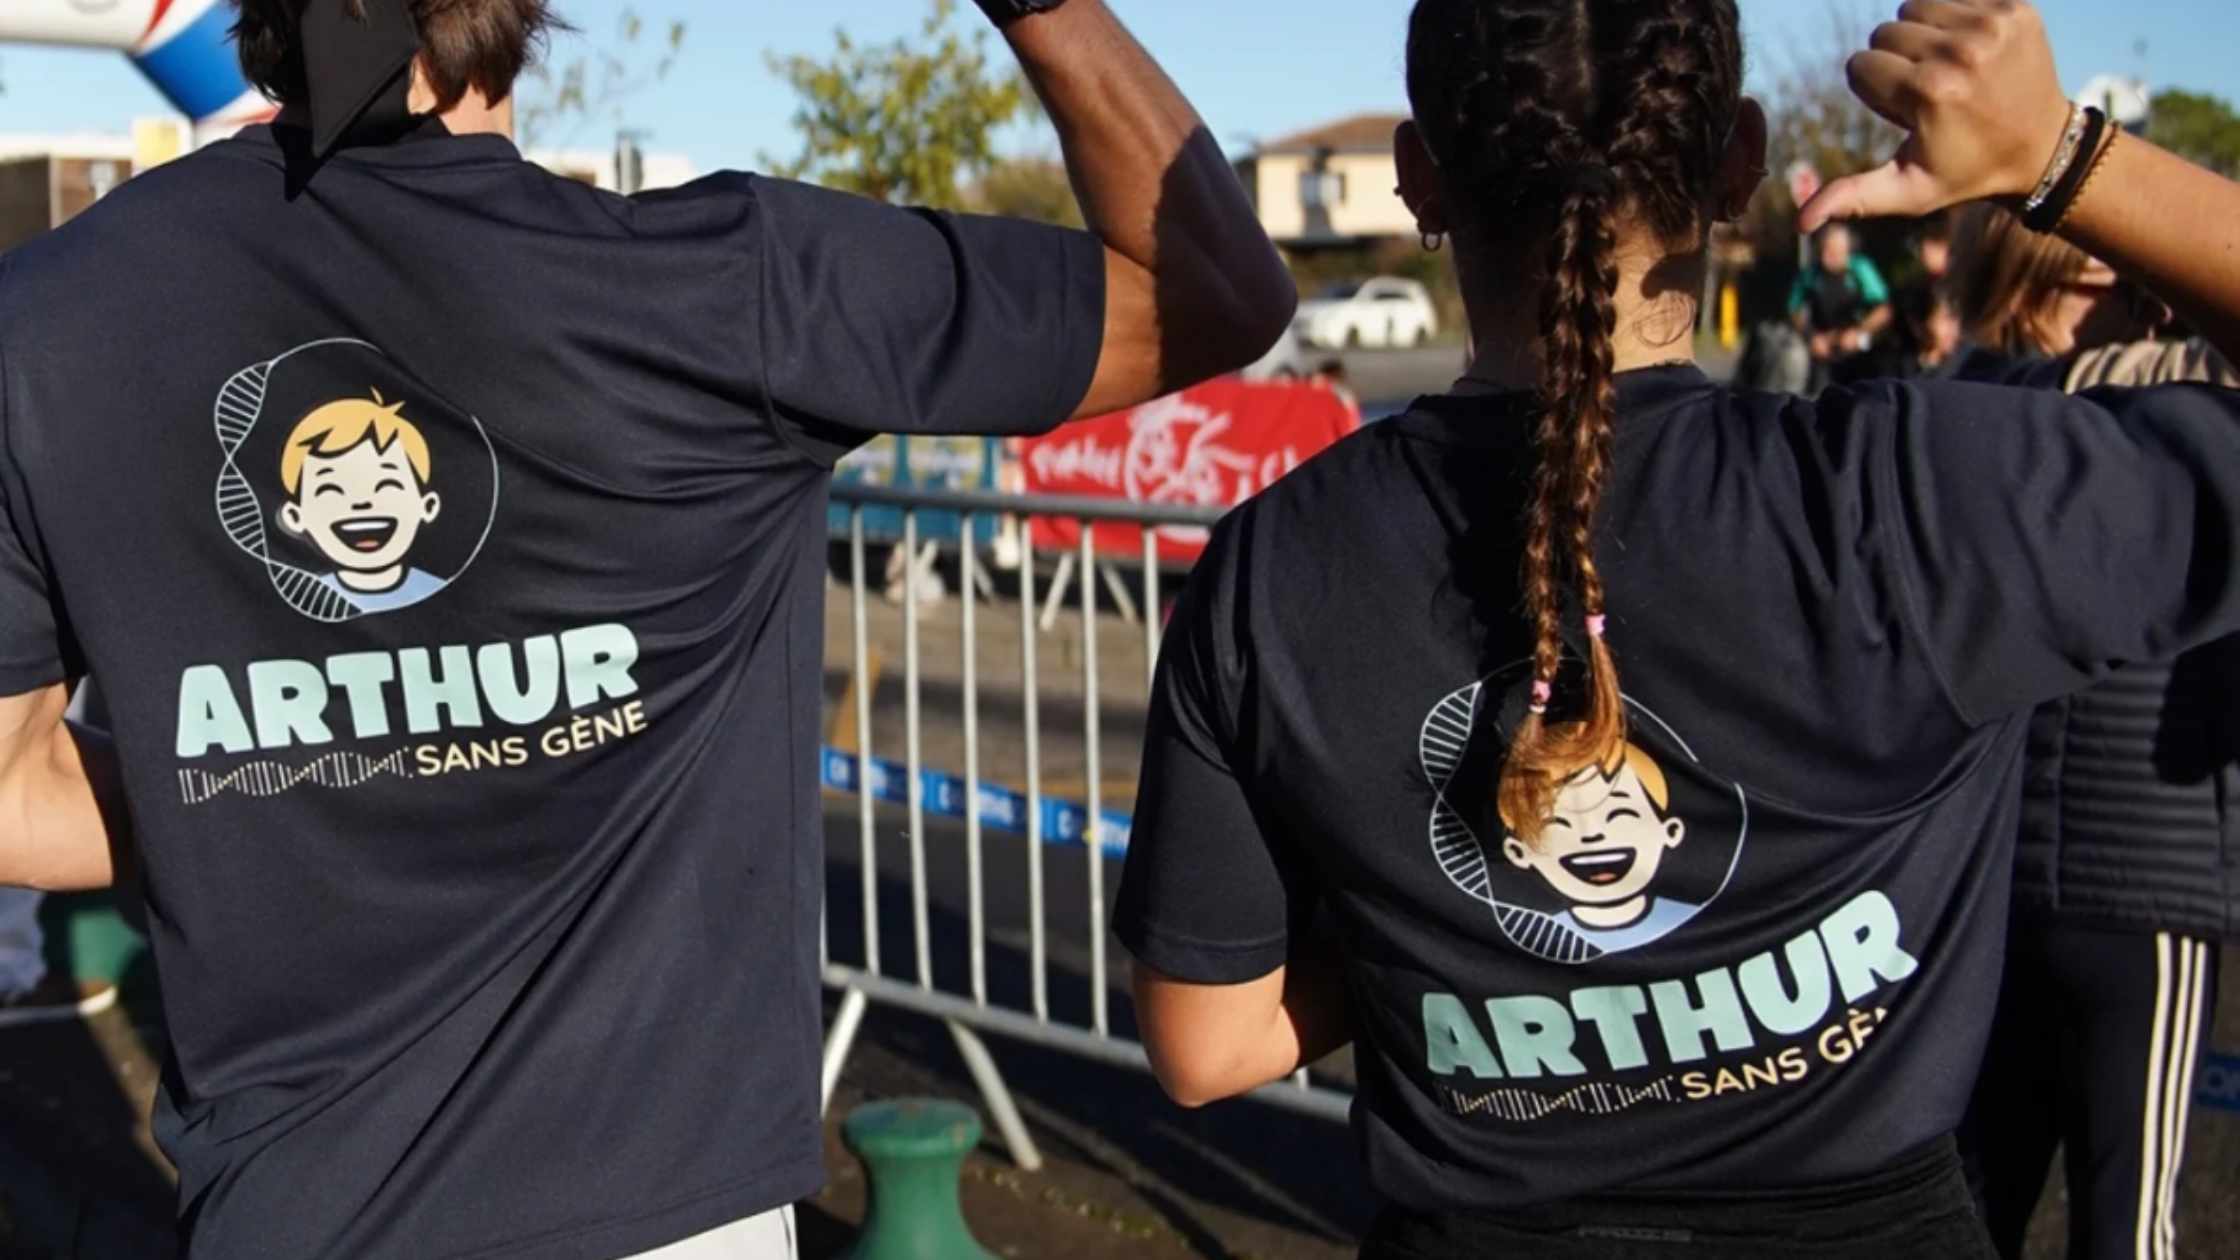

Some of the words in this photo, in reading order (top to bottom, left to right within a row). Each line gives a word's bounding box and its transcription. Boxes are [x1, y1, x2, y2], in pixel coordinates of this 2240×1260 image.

[176, 623, 639, 757] ARTHUR
[415, 737, 529, 777] SANS
[541, 701, 648, 757] GÈNE
[1422, 890, 1918, 1079] ARTHUR
[1681, 1046, 1807, 1099] SANS
[1818, 1007, 1887, 1063] GÈ
